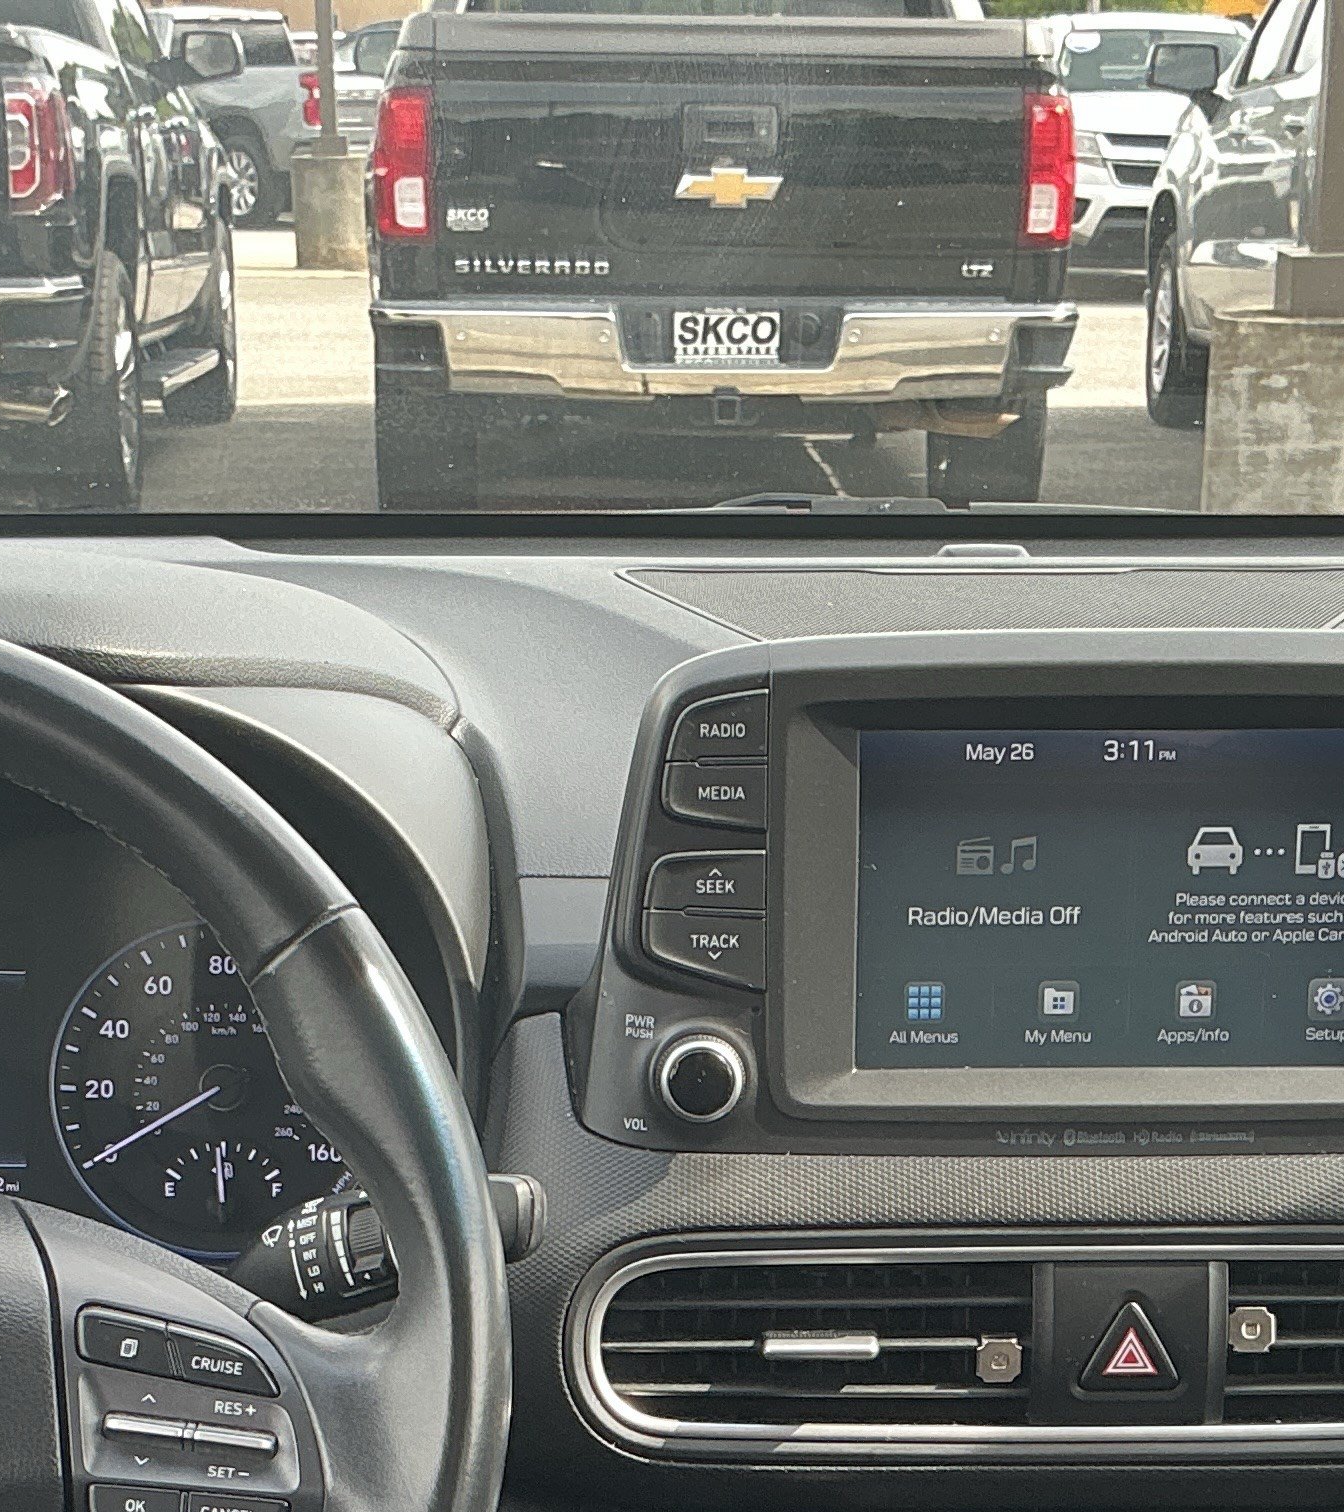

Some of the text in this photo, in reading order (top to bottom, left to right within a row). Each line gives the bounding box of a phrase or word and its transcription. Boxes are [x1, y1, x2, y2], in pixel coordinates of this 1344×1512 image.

[445, 207, 490, 221] SKCO
[454, 259, 610, 275] SILVERADO
[678, 316, 777, 345] SKCO
[699, 722, 747, 739] RADIO
[965, 741, 1035, 765] May 26
[697, 785, 746, 801] MEDIA
[695, 878, 735, 895] SEEK
[1175, 893, 1226, 907] Please
[1229, 893, 1292, 907] connect
[1295, 896, 1305, 907] a
[907, 905, 1081, 927] Radio/Media Off
[1167, 911, 1190, 925] for
[1194, 913, 1236, 925] more
[1239, 910, 1304, 925] features
[1307, 910, 1340, 924] such
[690, 933, 740, 949] TRACK
[1148, 928, 1207, 943] Android
[1211, 928, 1247, 943] Auto
[1252, 931, 1268, 943] or
[1272, 927, 1315, 945] Apple
[209, 955, 236, 975] 80
[144, 976, 172, 996] 60
[203, 1012, 221, 1023] 120
[228, 1012, 247, 1023] 140
[624, 1014, 655, 1028] PWR
[99, 1019, 130, 1040] 40
[181, 1021, 199, 1032] 100
[211, 1025, 238, 1036] km/h
[624, 1027, 654, 1040] PUSH
[164, 1034, 180, 1045] 80
[889, 1029, 959, 1043] All Menus
[1024, 1029, 1092, 1046] My Menu
[1157, 1027, 1229, 1045] Apps/Info
[150, 1053, 165, 1064] 60
[85, 1079, 115, 1099] 20
[145, 1101, 160, 1112] 20
[623, 1116, 648, 1131] VOL
[164, 1181, 176, 1197] E
[271, 1182, 283, 1198] F
[299, 1231, 317, 1246] OFF
[191, 1356, 244, 1376] CRUISE
